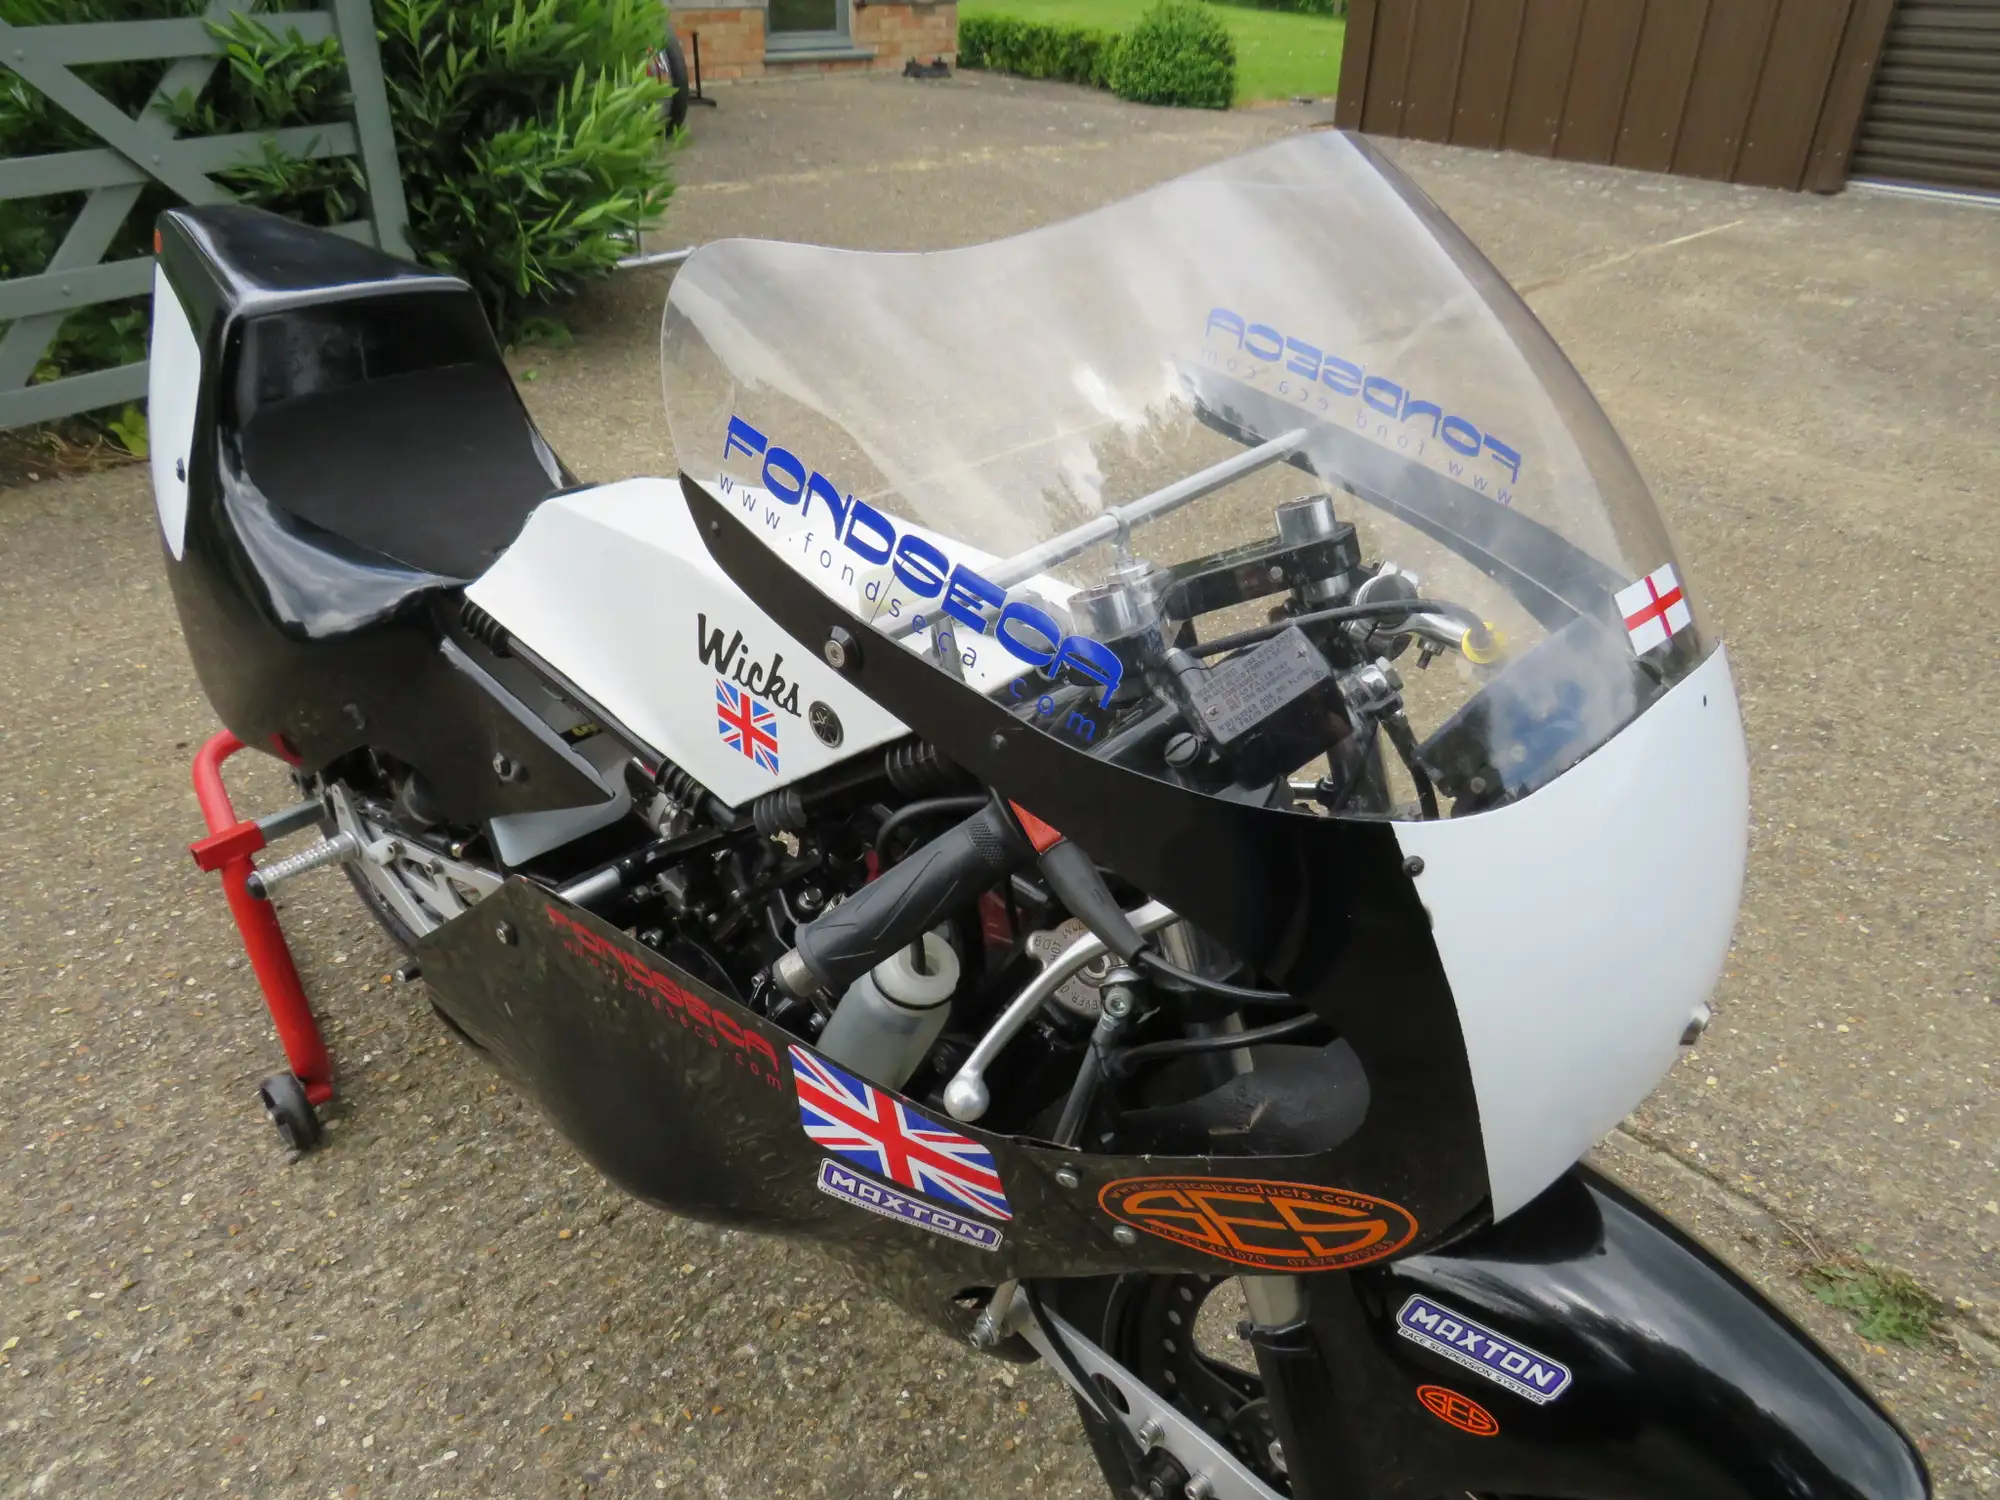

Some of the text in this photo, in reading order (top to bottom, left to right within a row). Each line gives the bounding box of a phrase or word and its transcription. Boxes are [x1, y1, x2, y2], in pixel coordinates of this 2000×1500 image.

[719, 472, 1097, 741] www.fondseca.com
[724, 414, 1124, 710] FONDSECA
[697, 613, 802, 718] Wicks
[830, 1169, 986, 1241] MAXTON
[1399, 1328, 1544, 1404] RACE SUSPENSION SYSTEMS
[1408, 1306, 1556, 1387] MAXTON
